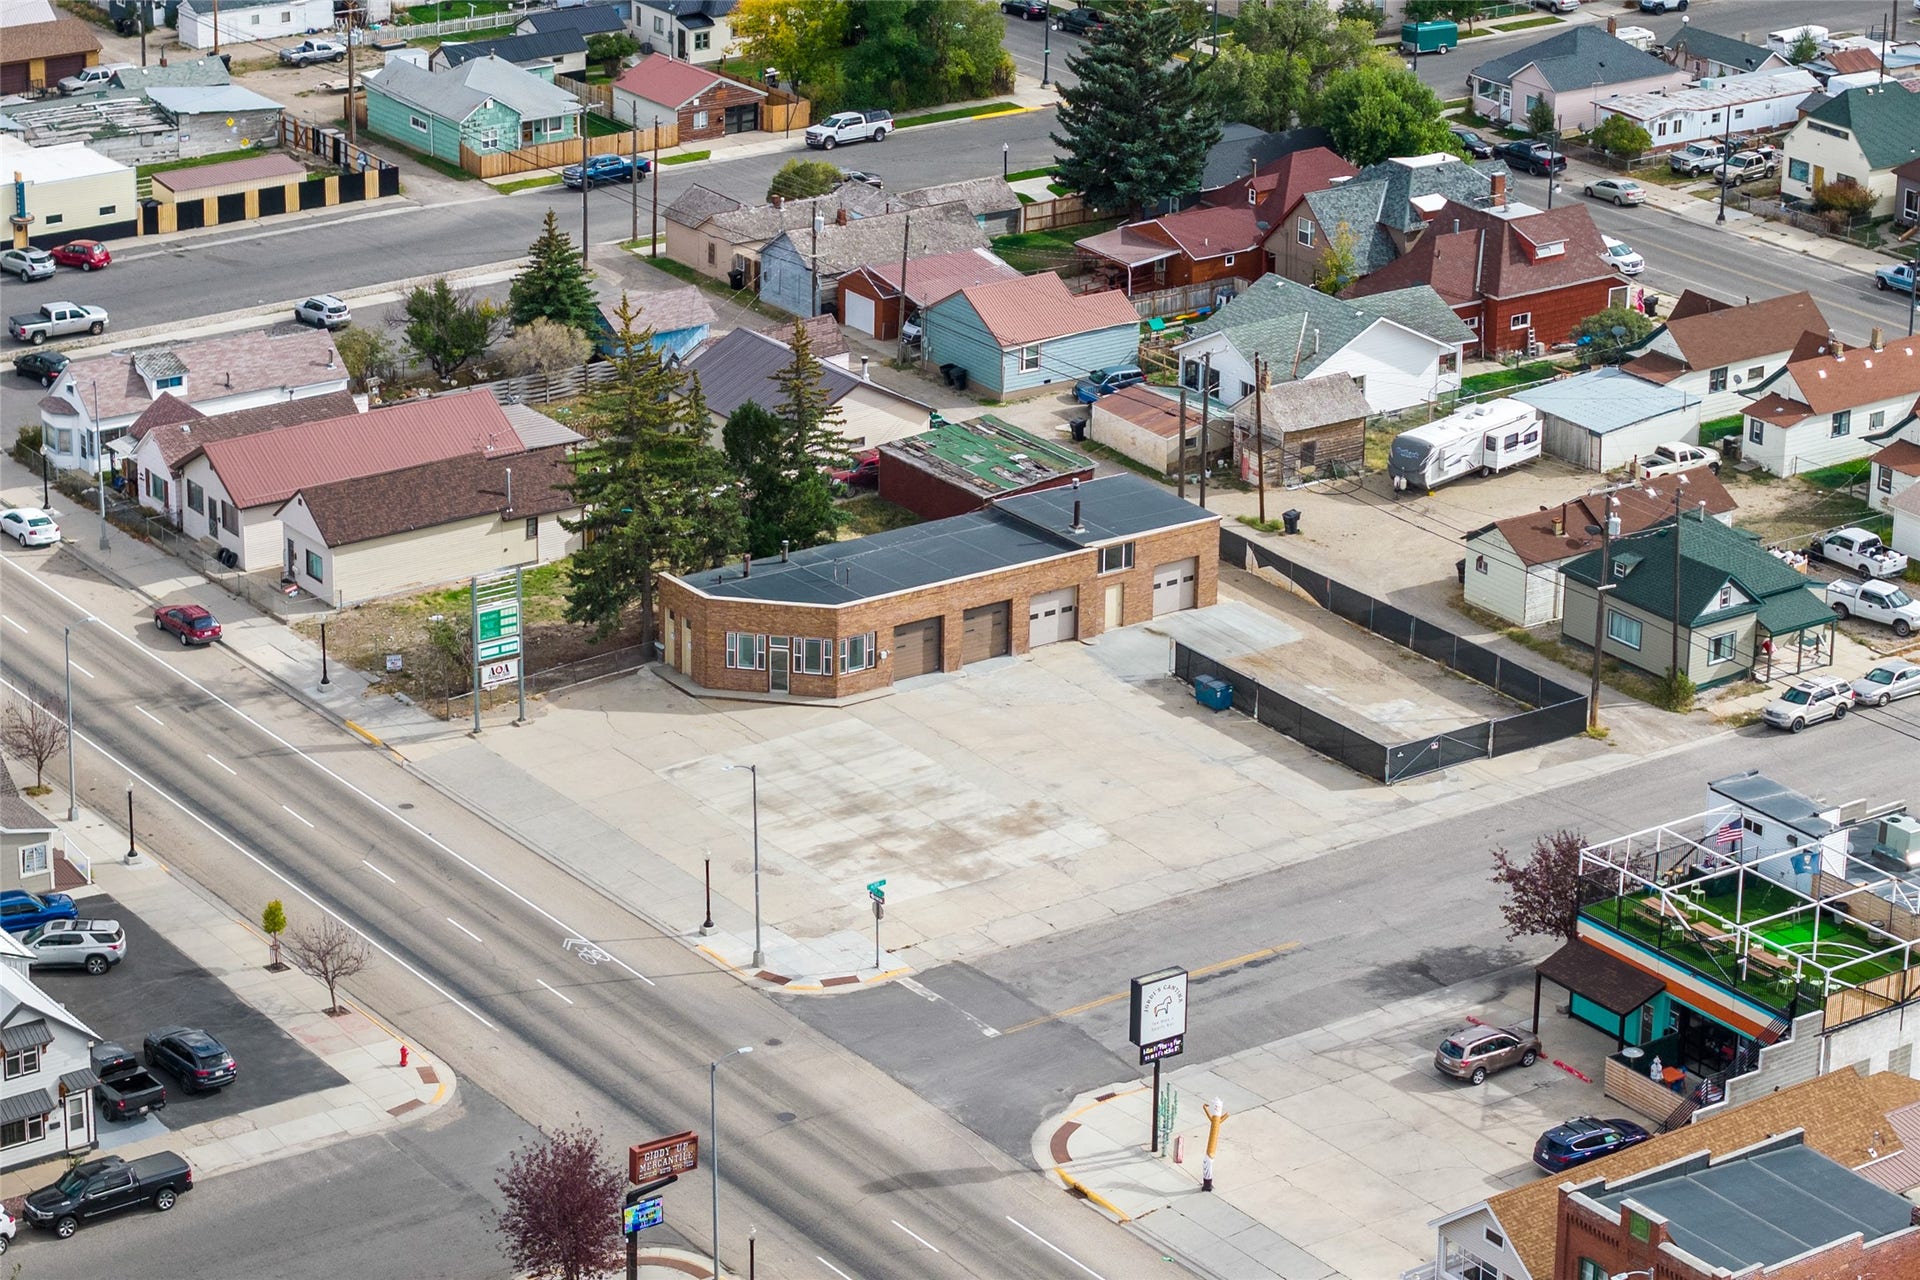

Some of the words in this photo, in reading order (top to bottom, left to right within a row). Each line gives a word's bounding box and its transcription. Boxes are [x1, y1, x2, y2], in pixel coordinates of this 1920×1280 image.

[1163, 984, 1183, 1003] CANTINA
[639, 1151, 694, 1173] MERCANTILE
[644, 1146, 671, 1162] GIDDY
[676, 1142, 689, 1153] UP
